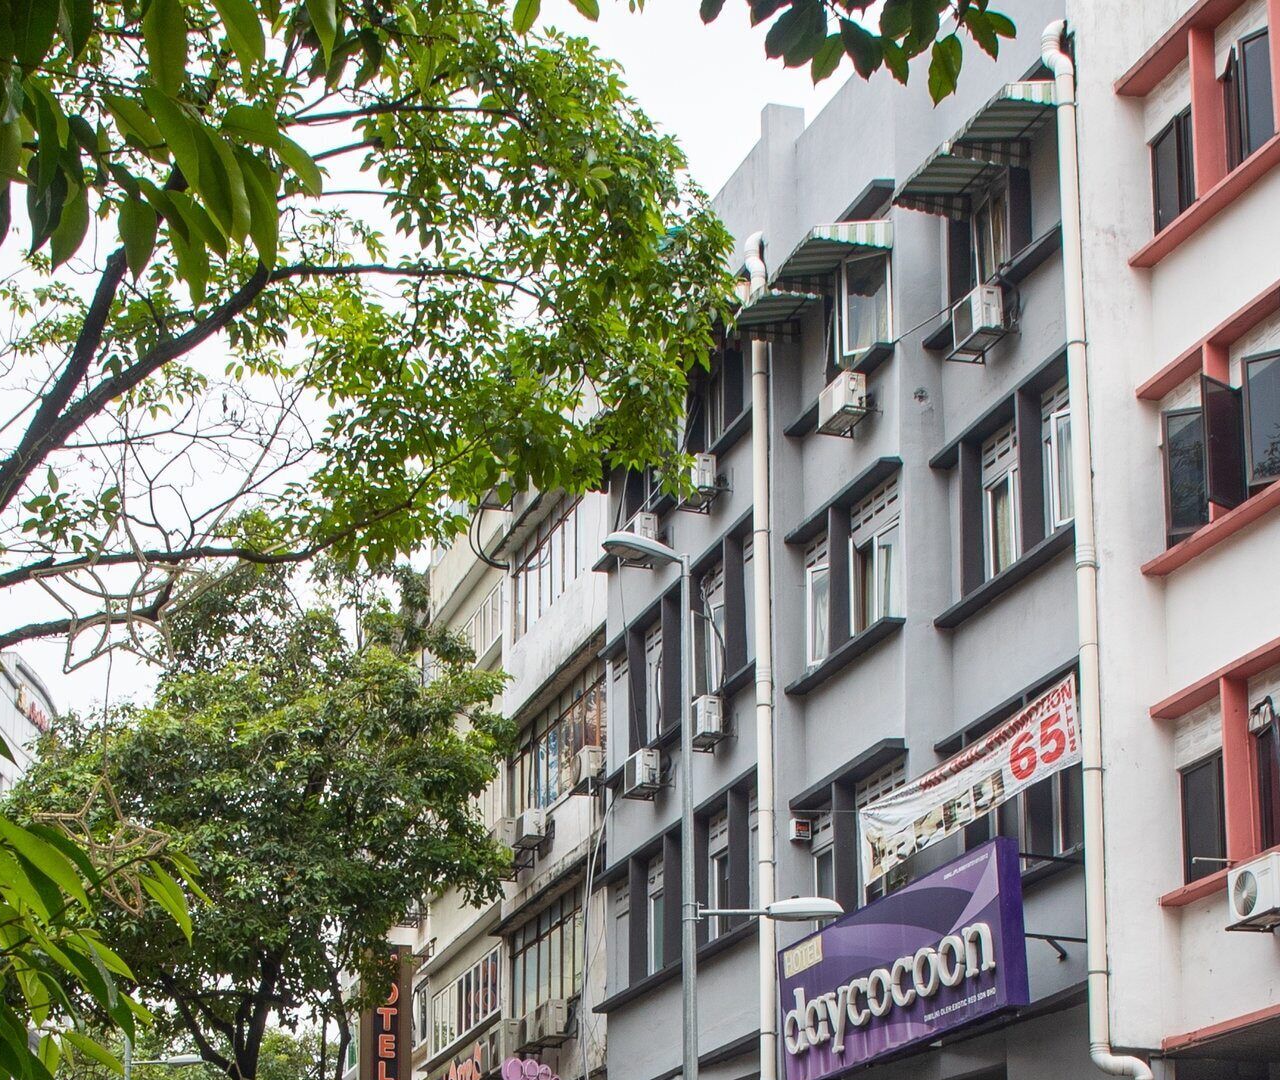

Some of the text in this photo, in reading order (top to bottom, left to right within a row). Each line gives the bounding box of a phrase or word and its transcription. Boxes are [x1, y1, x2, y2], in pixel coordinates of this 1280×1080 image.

[1009, 711, 1066, 781] 65
[784, 941, 821, 975] HOTEL
[784, 922, 996, 1055] daycocoon
